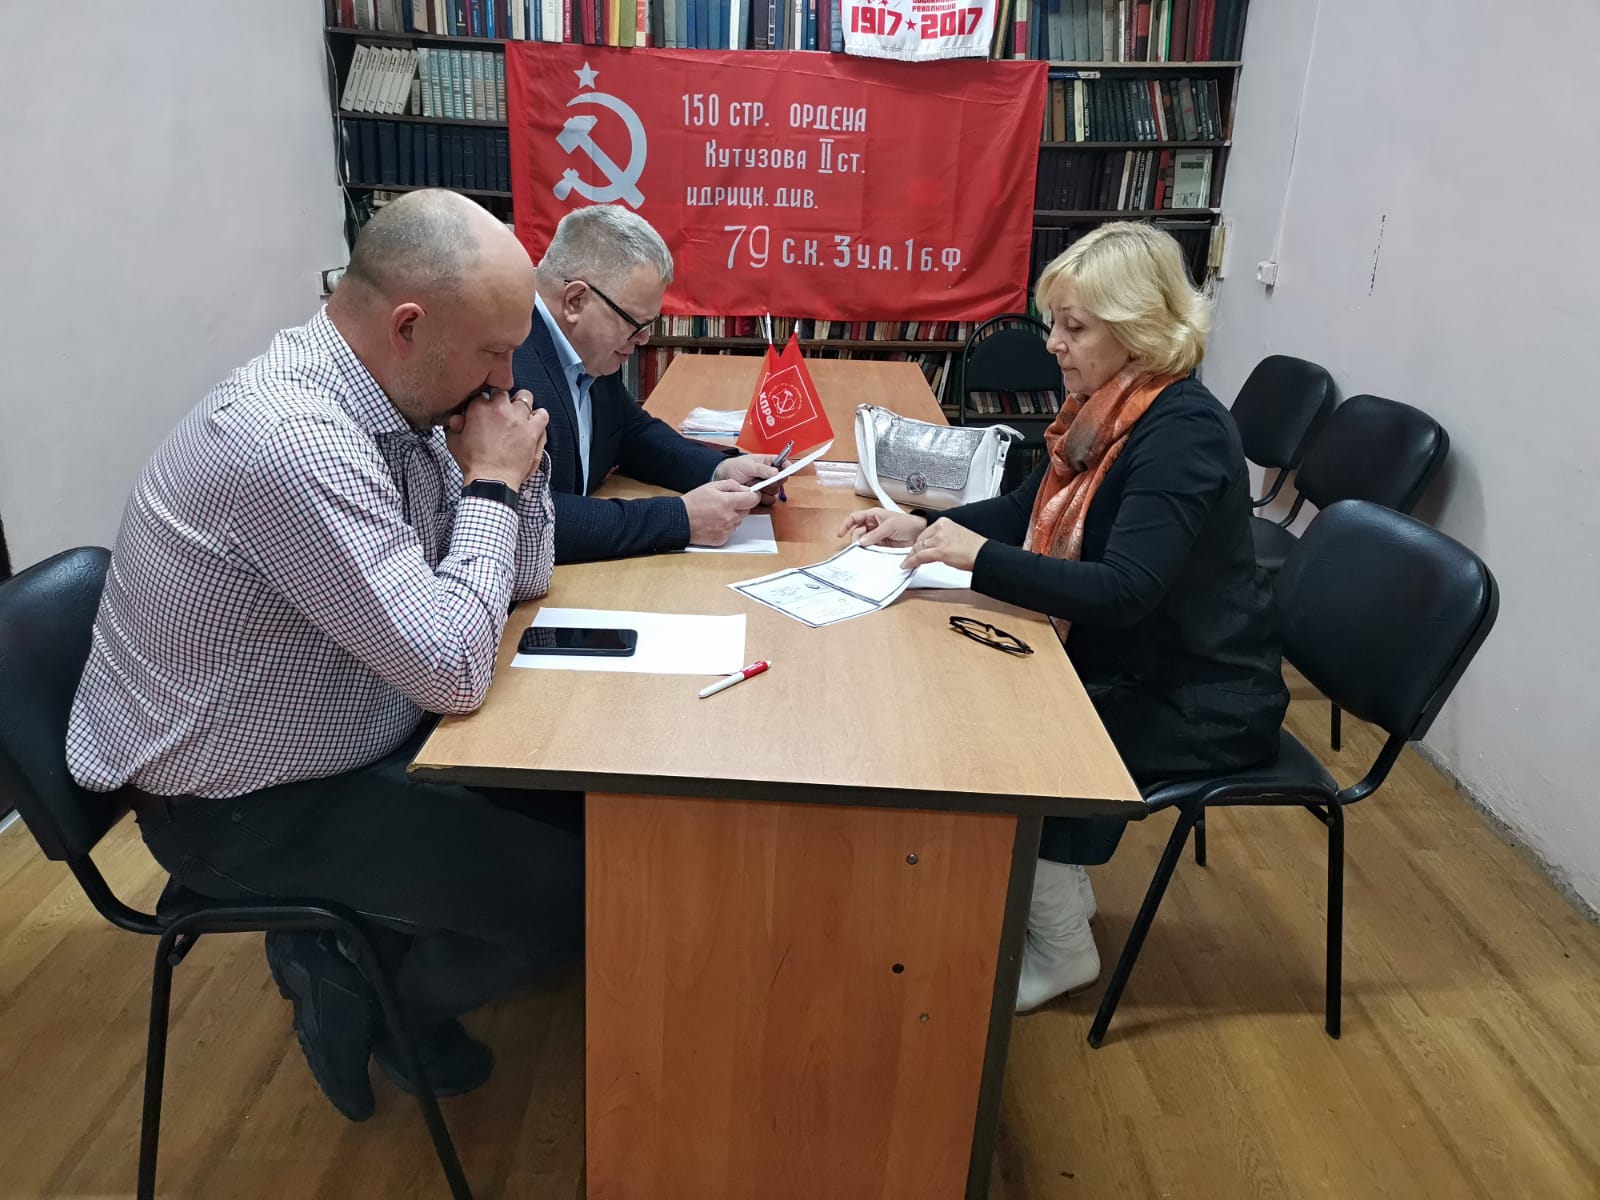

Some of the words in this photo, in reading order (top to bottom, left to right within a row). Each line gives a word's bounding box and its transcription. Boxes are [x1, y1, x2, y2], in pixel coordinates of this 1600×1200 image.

[851, 6, 903, 36] 1917
[921, 7, 983, 40] 2017
[682, 93, 719, 127] 150
[729, 102, 769, 127] СТР.
[789, 104, 867, 132] ОРДЕНА
[687, 186, 769, 209] ИДРИЦК.
[773, 187, 818, 209] ДИВ.
[724, 225, 770, 270] 79
[760, 391, 776, 427] КПРФ
